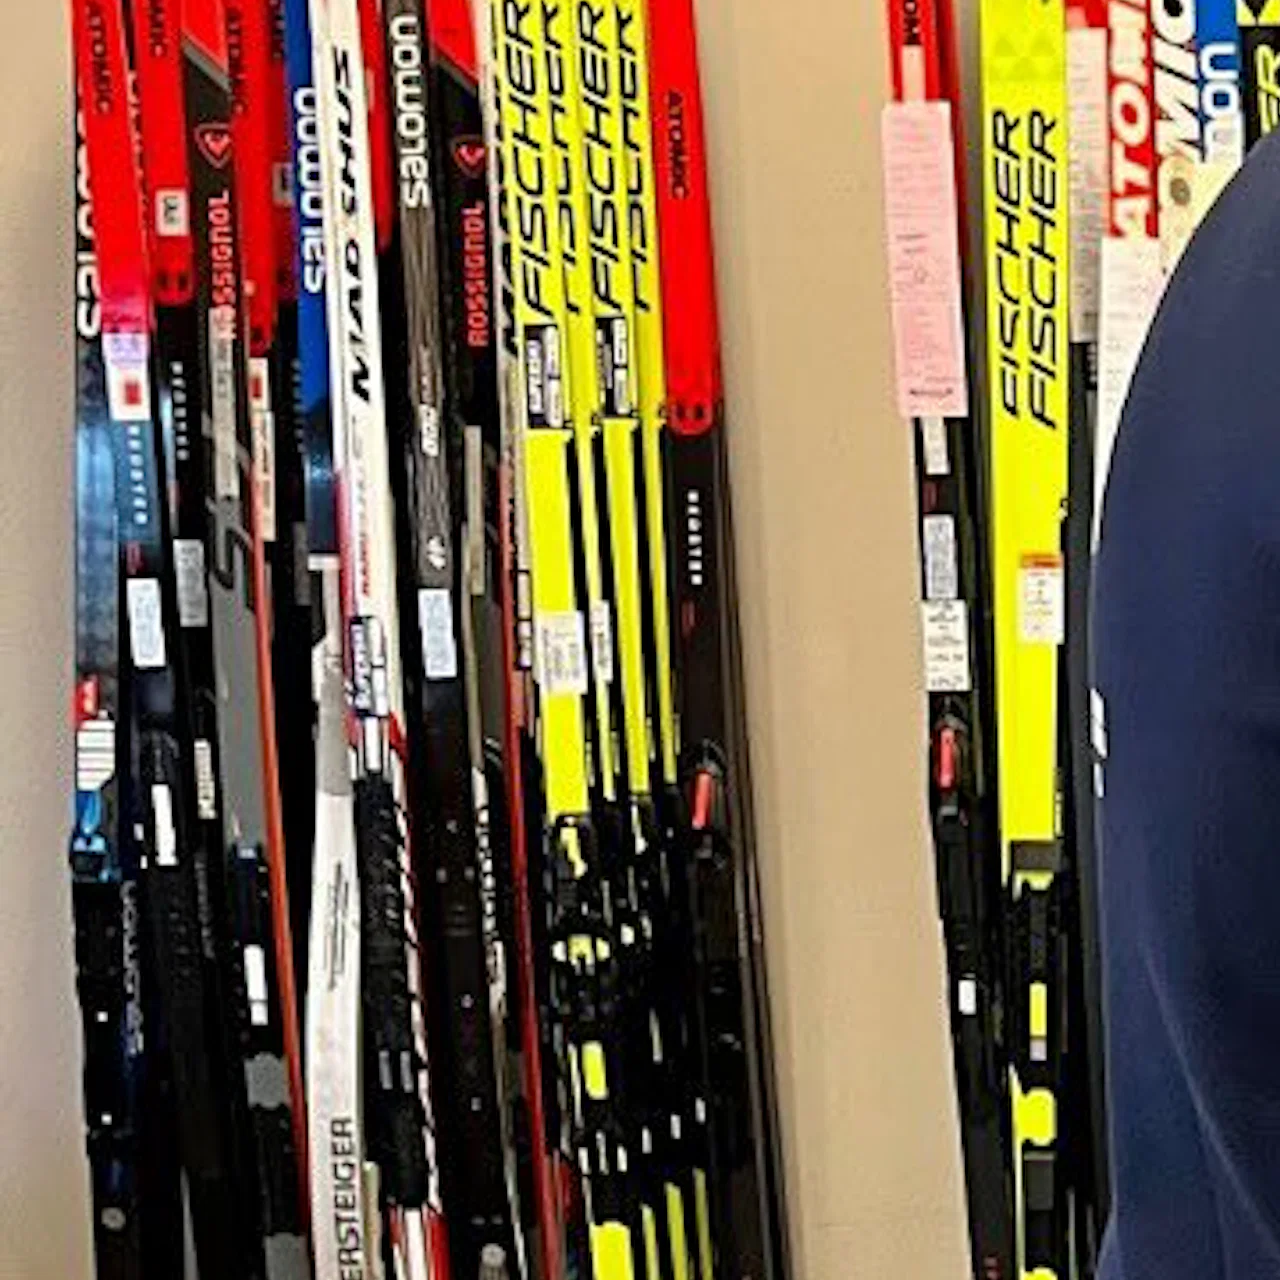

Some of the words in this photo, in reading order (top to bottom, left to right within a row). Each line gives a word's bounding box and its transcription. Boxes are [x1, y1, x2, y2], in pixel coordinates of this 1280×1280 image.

[331, 46, 371, 403] MADSHUS
[388, 15, 433, 209] salomon
[577, 0, 623, 311] FISCHER
[664, 91, 692, 200] ATOMIC
[992, 107, 1022, 418] FISCHER
[461, 200, 489, 348] ROSSIGNOL
[1028, 109, 1058, 430] FISCHER
